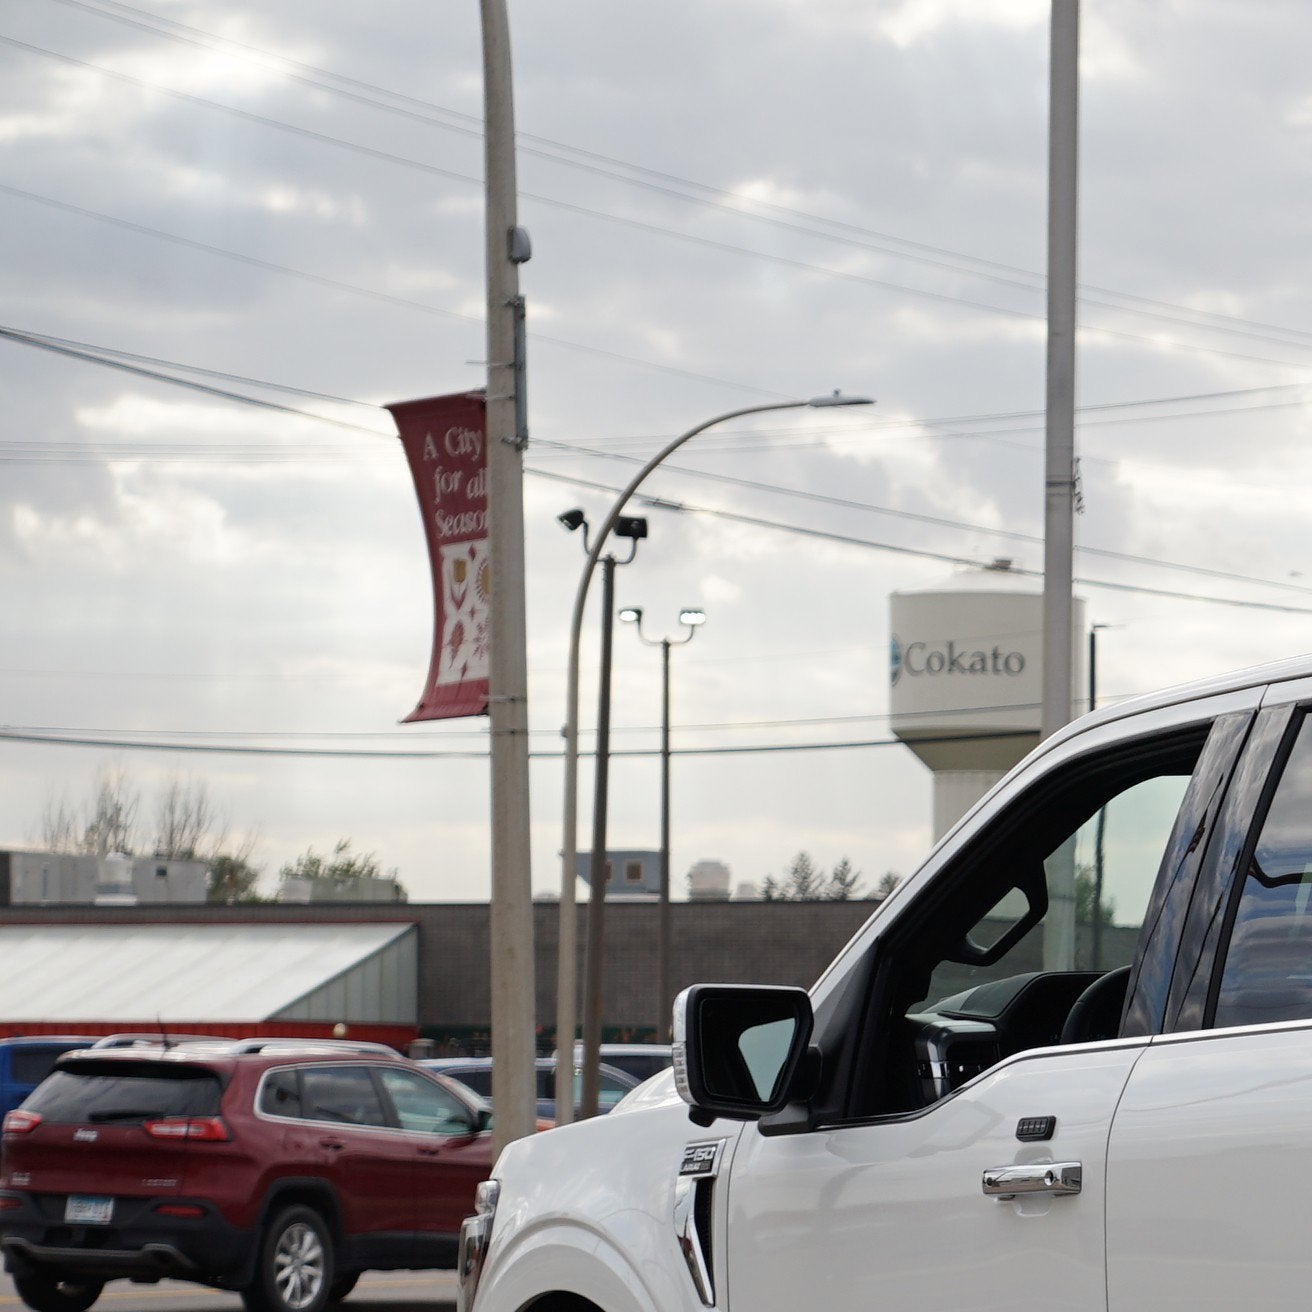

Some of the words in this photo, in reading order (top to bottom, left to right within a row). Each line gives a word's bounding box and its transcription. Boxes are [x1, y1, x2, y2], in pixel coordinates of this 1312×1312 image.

[423, 432, 439, 461] A
[445, 426, 482, 461] City
[434, 465, 463, 504] for
[905, 641, 1026, 677] Cokato
